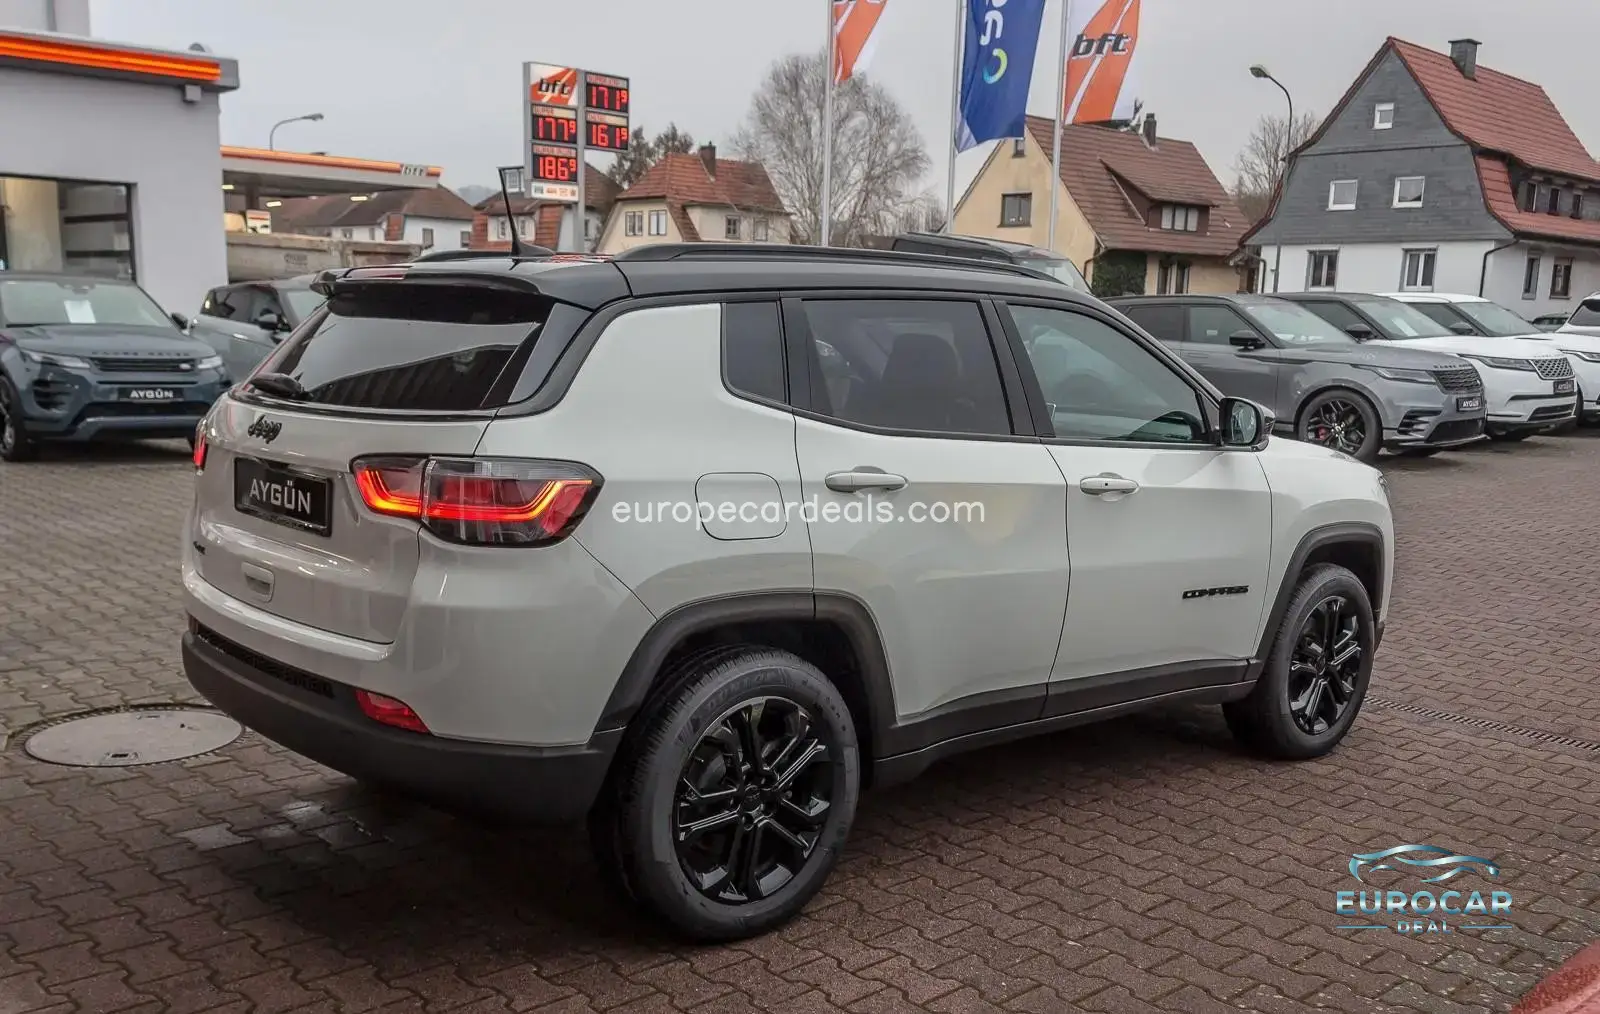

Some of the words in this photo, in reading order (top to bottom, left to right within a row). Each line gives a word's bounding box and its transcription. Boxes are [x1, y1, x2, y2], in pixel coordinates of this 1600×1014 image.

[1071, 33, 1131, 58] bft
[538, 78, 571, 96] bft
[129, 388, 174, 399] AYGÜN
[247, 414, 283, 445] Jeep
[249, 477, 312, 515] AYGÜN
